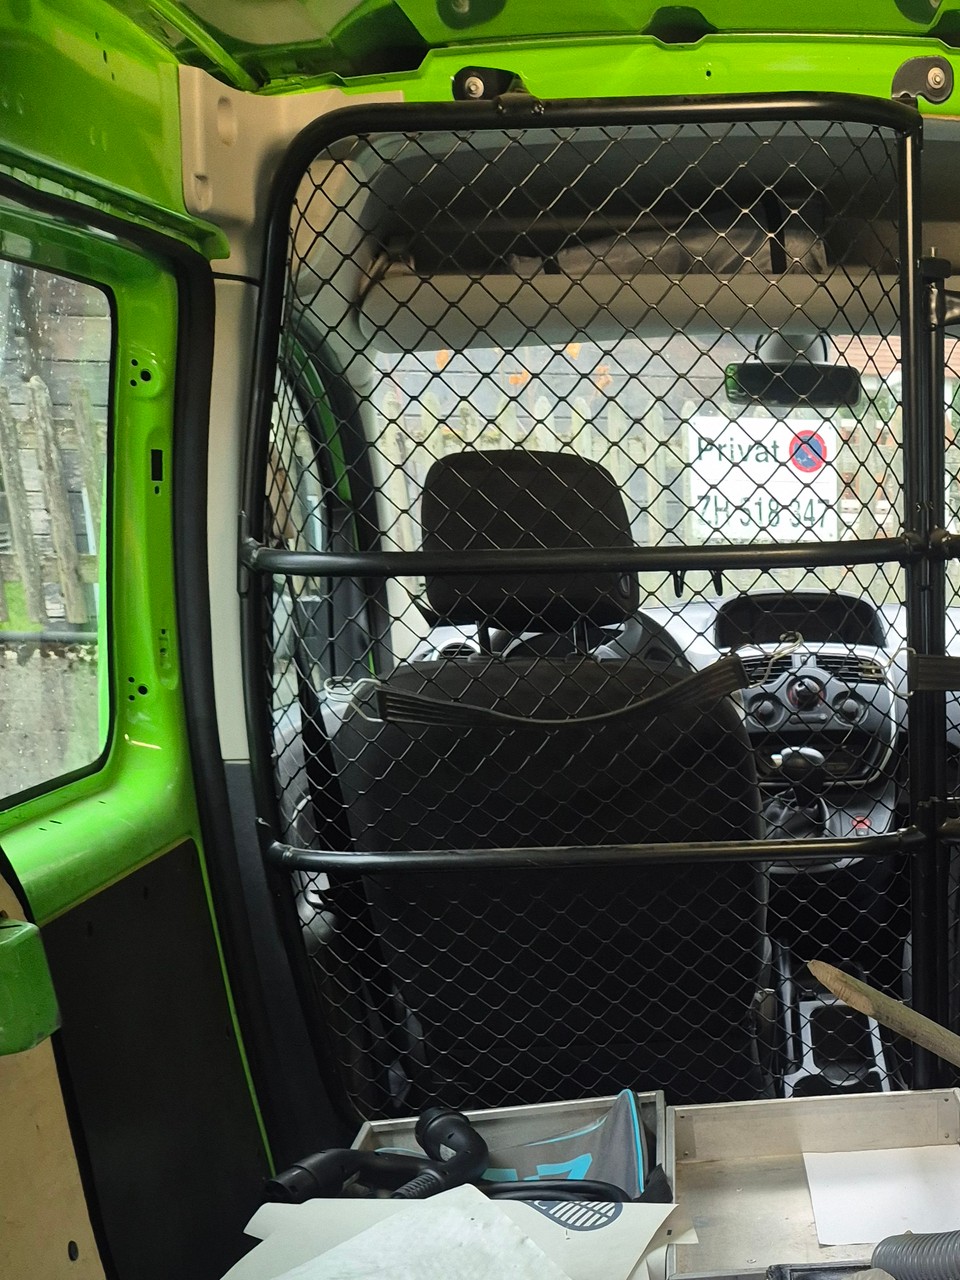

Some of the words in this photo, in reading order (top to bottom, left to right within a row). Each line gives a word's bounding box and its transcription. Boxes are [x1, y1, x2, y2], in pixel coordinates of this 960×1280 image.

[697, 437, 780, 463] Privat
[697, 495, 730, 526] ZH
[789, 498, 830, 528] 347
